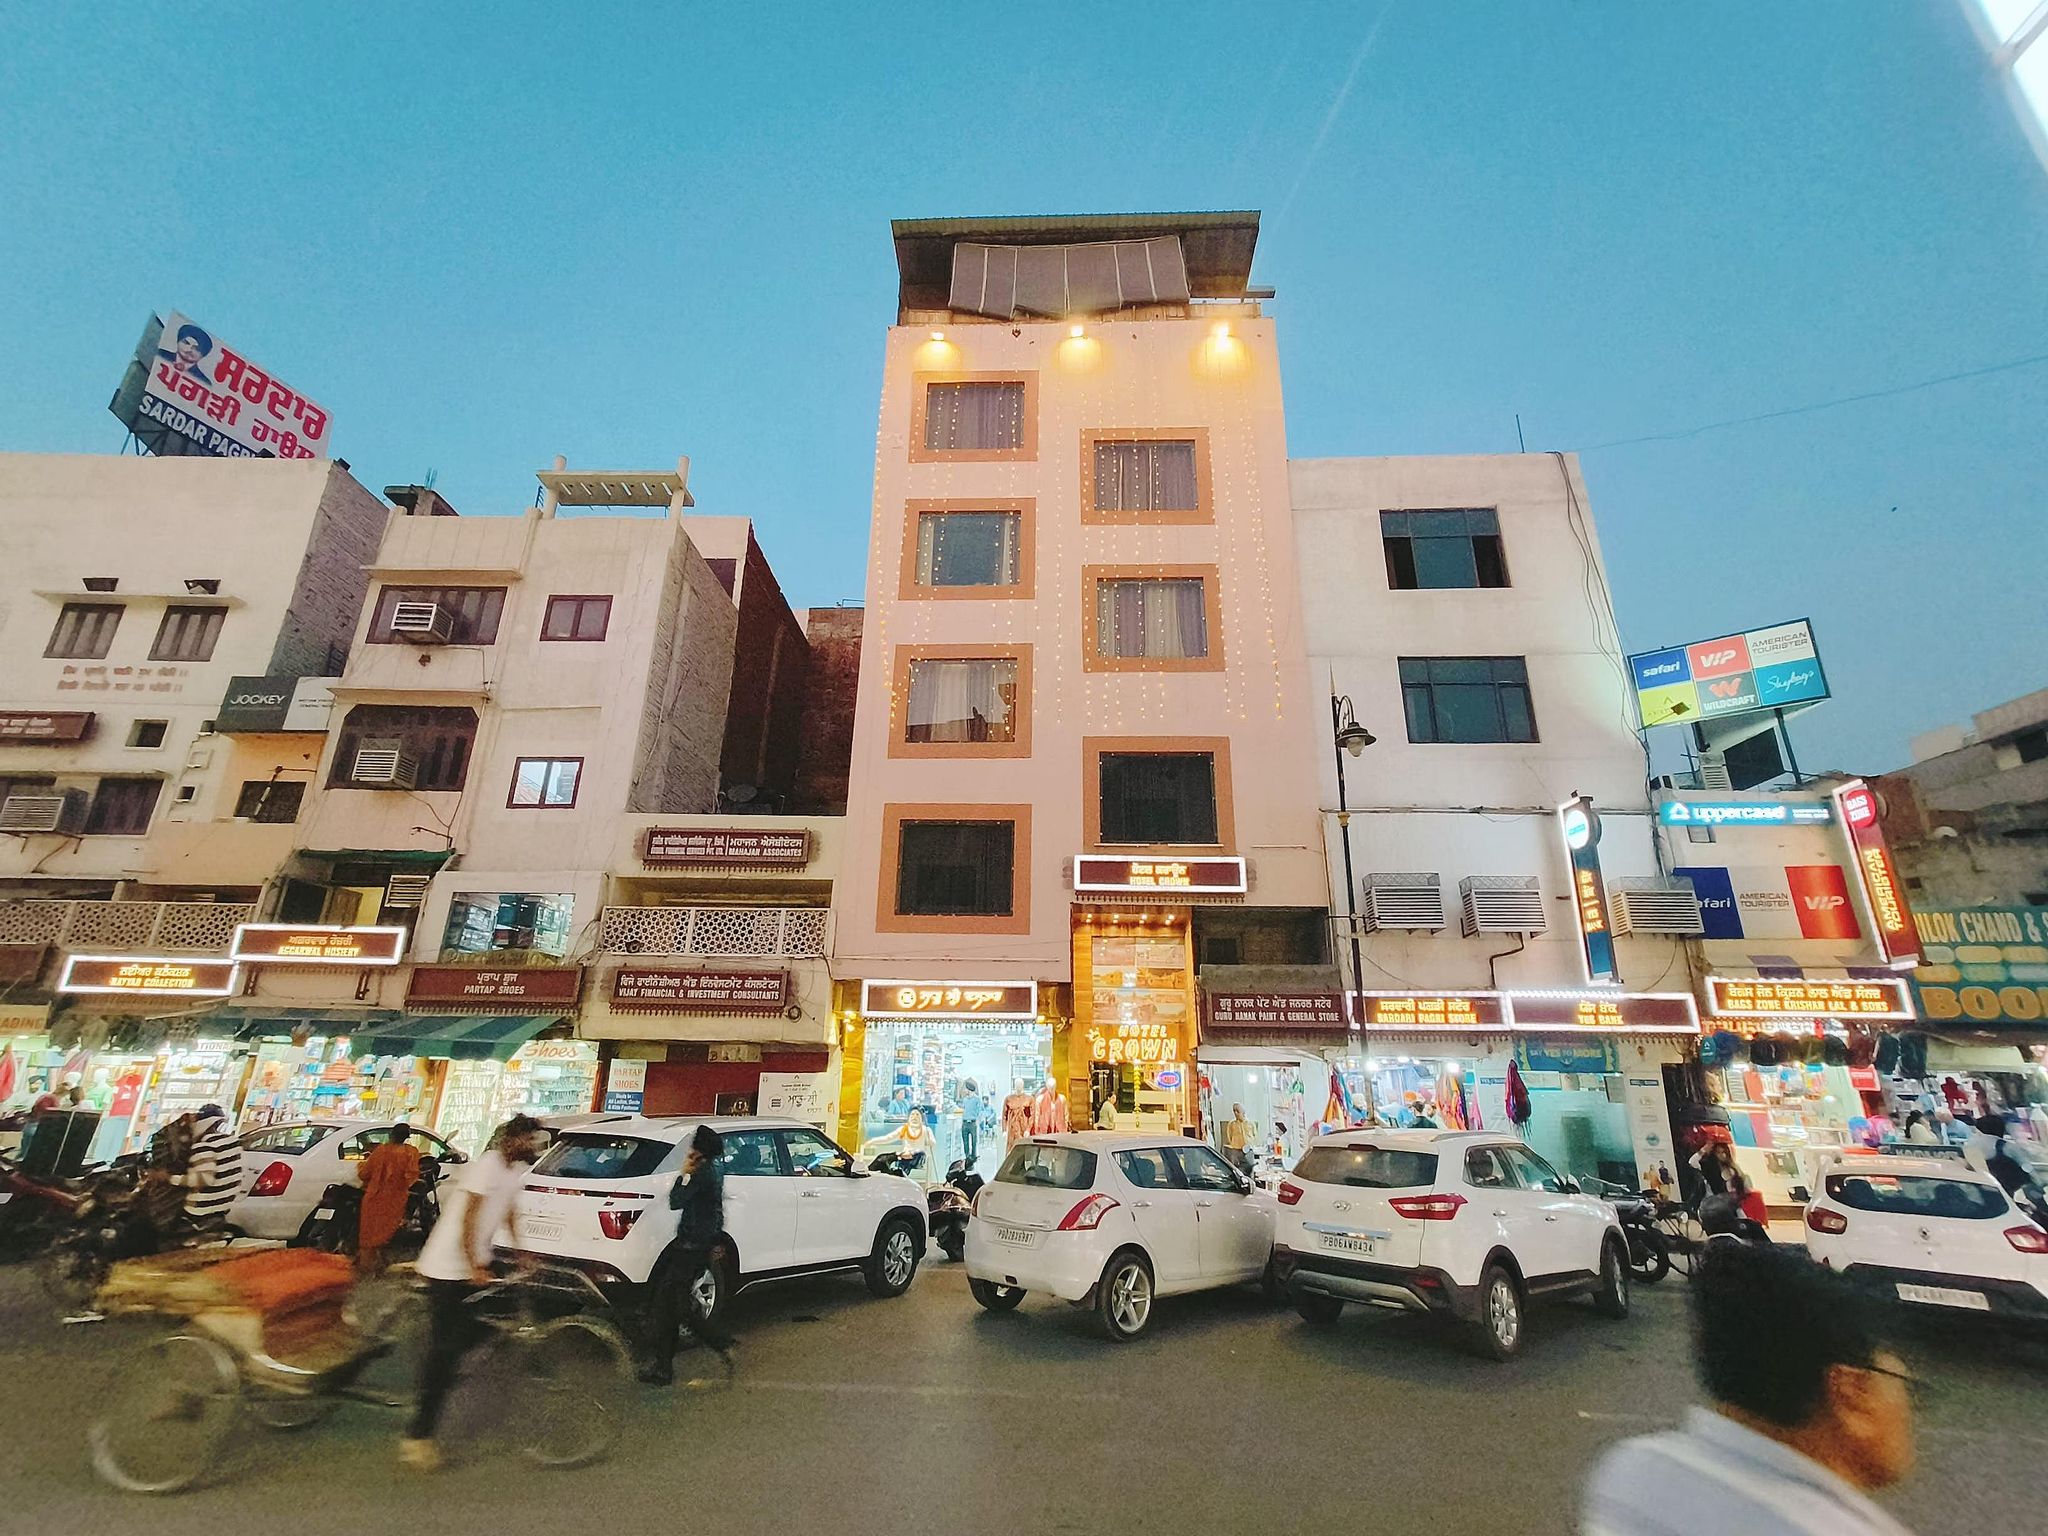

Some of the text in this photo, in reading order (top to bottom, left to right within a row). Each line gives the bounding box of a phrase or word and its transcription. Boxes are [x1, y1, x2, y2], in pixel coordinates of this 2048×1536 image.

[214, 347, 327, 440] ਸਰਦਾਰ
[139, 396, 256, 458] SARDAR PAGR
[1751, 630, 1807, 648] AMERICAN
[1751, 638, 1808, 654] TOURISTER
[1700, 649, 1737, 668] VIP
[1643, 661, 1681, 678] safari
[230, 694, 286, 705] JOCKEY
[1703, 694, 1755, 711] WILDCRAFT
[1693, 806, 1785, 823] uppercase
[729, 848, 802, 857] MAHAJAN ASSOCIATES
[1130, 876, 1190, 886] HOTEL CROWN
[1864, 850, 1899, 931] AMERICAN
[1872, 848, 1904, 928] TOURISTER
[1698, 897, 1731, 908] afari
[1740, 900, 1790, 908] TOURISTER
[1804, 896, 1845, 910] VIP
[1959, 912, 2023, 943] CHAND
[2024, 912, 2043, 943] &
[143, 978, 194, 988] COLLECTION
[464, 985, 525, 995] PARTAP SHOES
[618, 988, 779, 1000] VIJAY FINANCIAL & INVESTMENT CONSULTANTS
[1234, 998, 1255, 1008] ਨਾਨਕ
[1728, 999, 1753, 1010] BAGS
[1756, 999, 1781, 1010] ZONE
[1784, 999, 1825, 1011] KRISHAN
[1828, 1000, 1848, 1011] LAL
[1861, 1001, 1889, 1012] SONS
[1214, 1011, 1340, 1022] GURU NANAK PAINT & GENERAL STORE
[1376, 1013, 1416, 1023] SARDARI
[1447, 1013, 1478, 1023] STORE
[1578, 1014, 1624, 1025] YES BANK
[1118, 1025, 1168, 1038] HOTEL
[524, 1041, 577, 1058] Shoes
[1093, 1038, 1177, 1060] CROWN
[614, 1068, 643, 1076] PARTAP
[615, 1080, 639, 1088] SHOES
